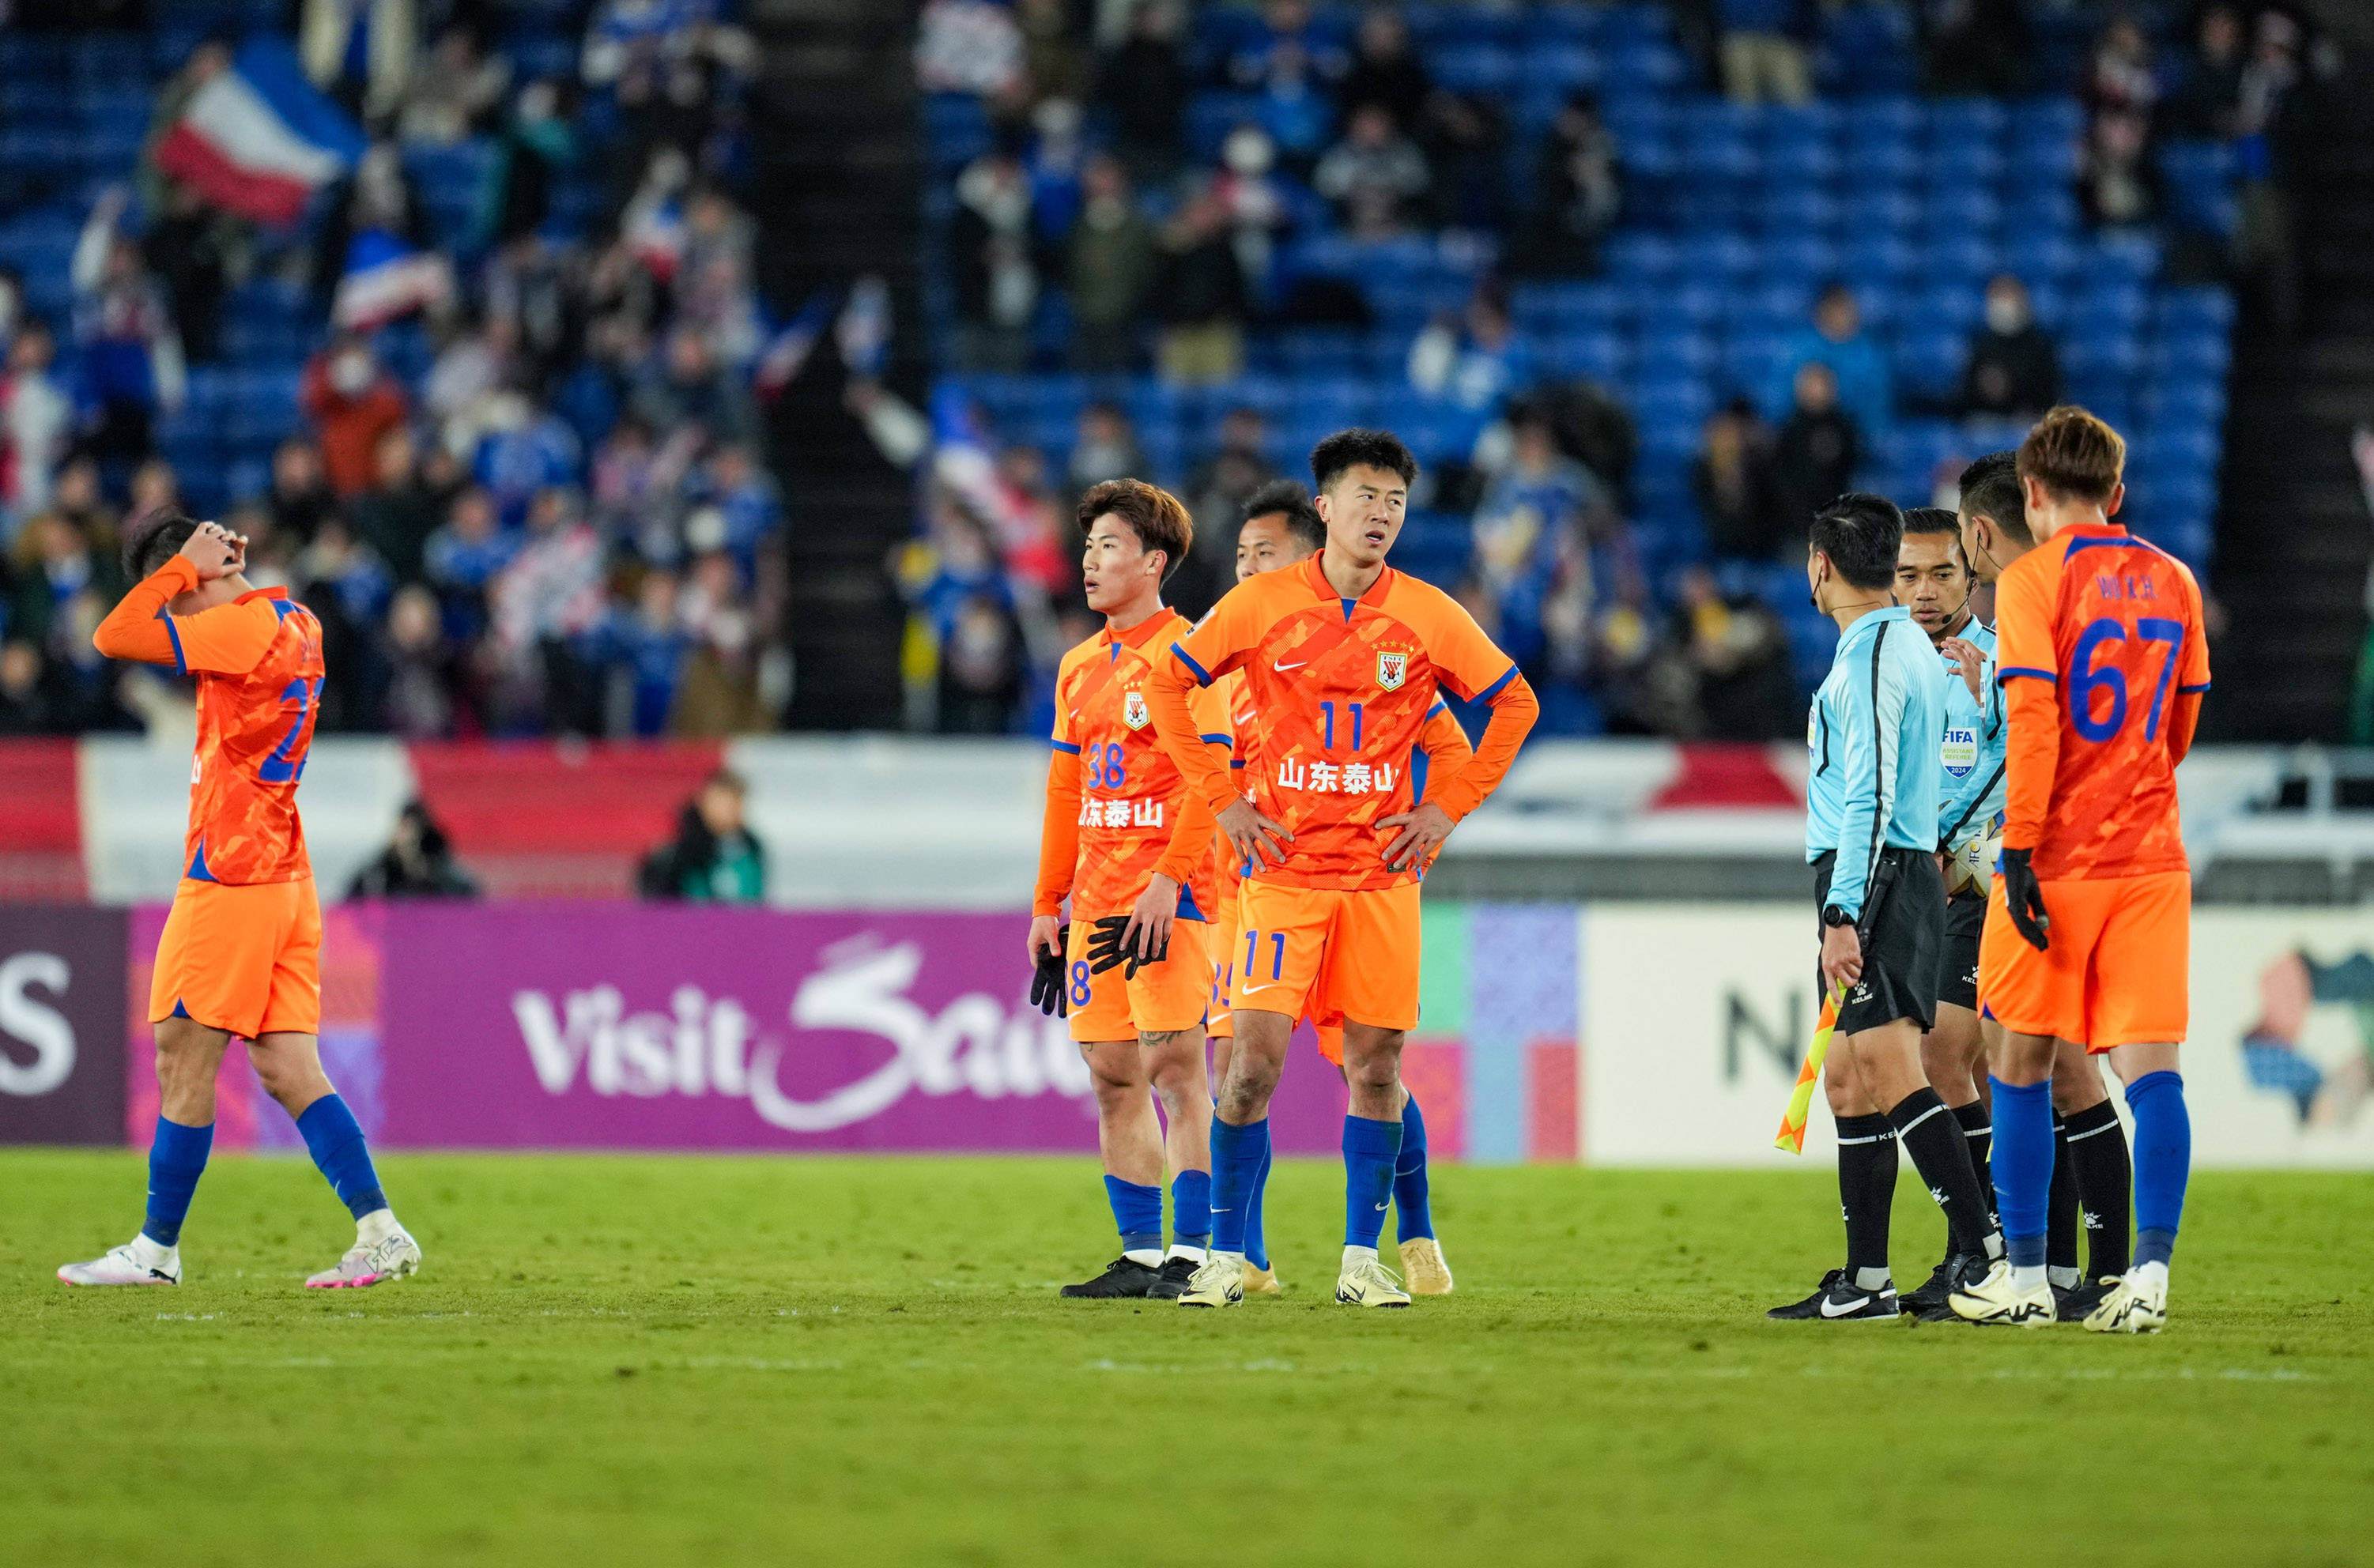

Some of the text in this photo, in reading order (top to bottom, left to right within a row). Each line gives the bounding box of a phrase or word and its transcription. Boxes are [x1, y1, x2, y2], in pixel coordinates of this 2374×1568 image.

[2069, 617, 2184, 743] 67
[1320, 701, 1362, 751] 11
[1942, 731, 1973, 743] FIFA
[1089, 743, 1125, 789] 38
[1278, 757, 1399, 795] 山东泰山
[1245, 930, 1285, 980] 11
[1065, 960, 1091, 1007] 8
[1851, 993, 1874, 1004] KELME
[514, 986, 749, 1097] Visit
